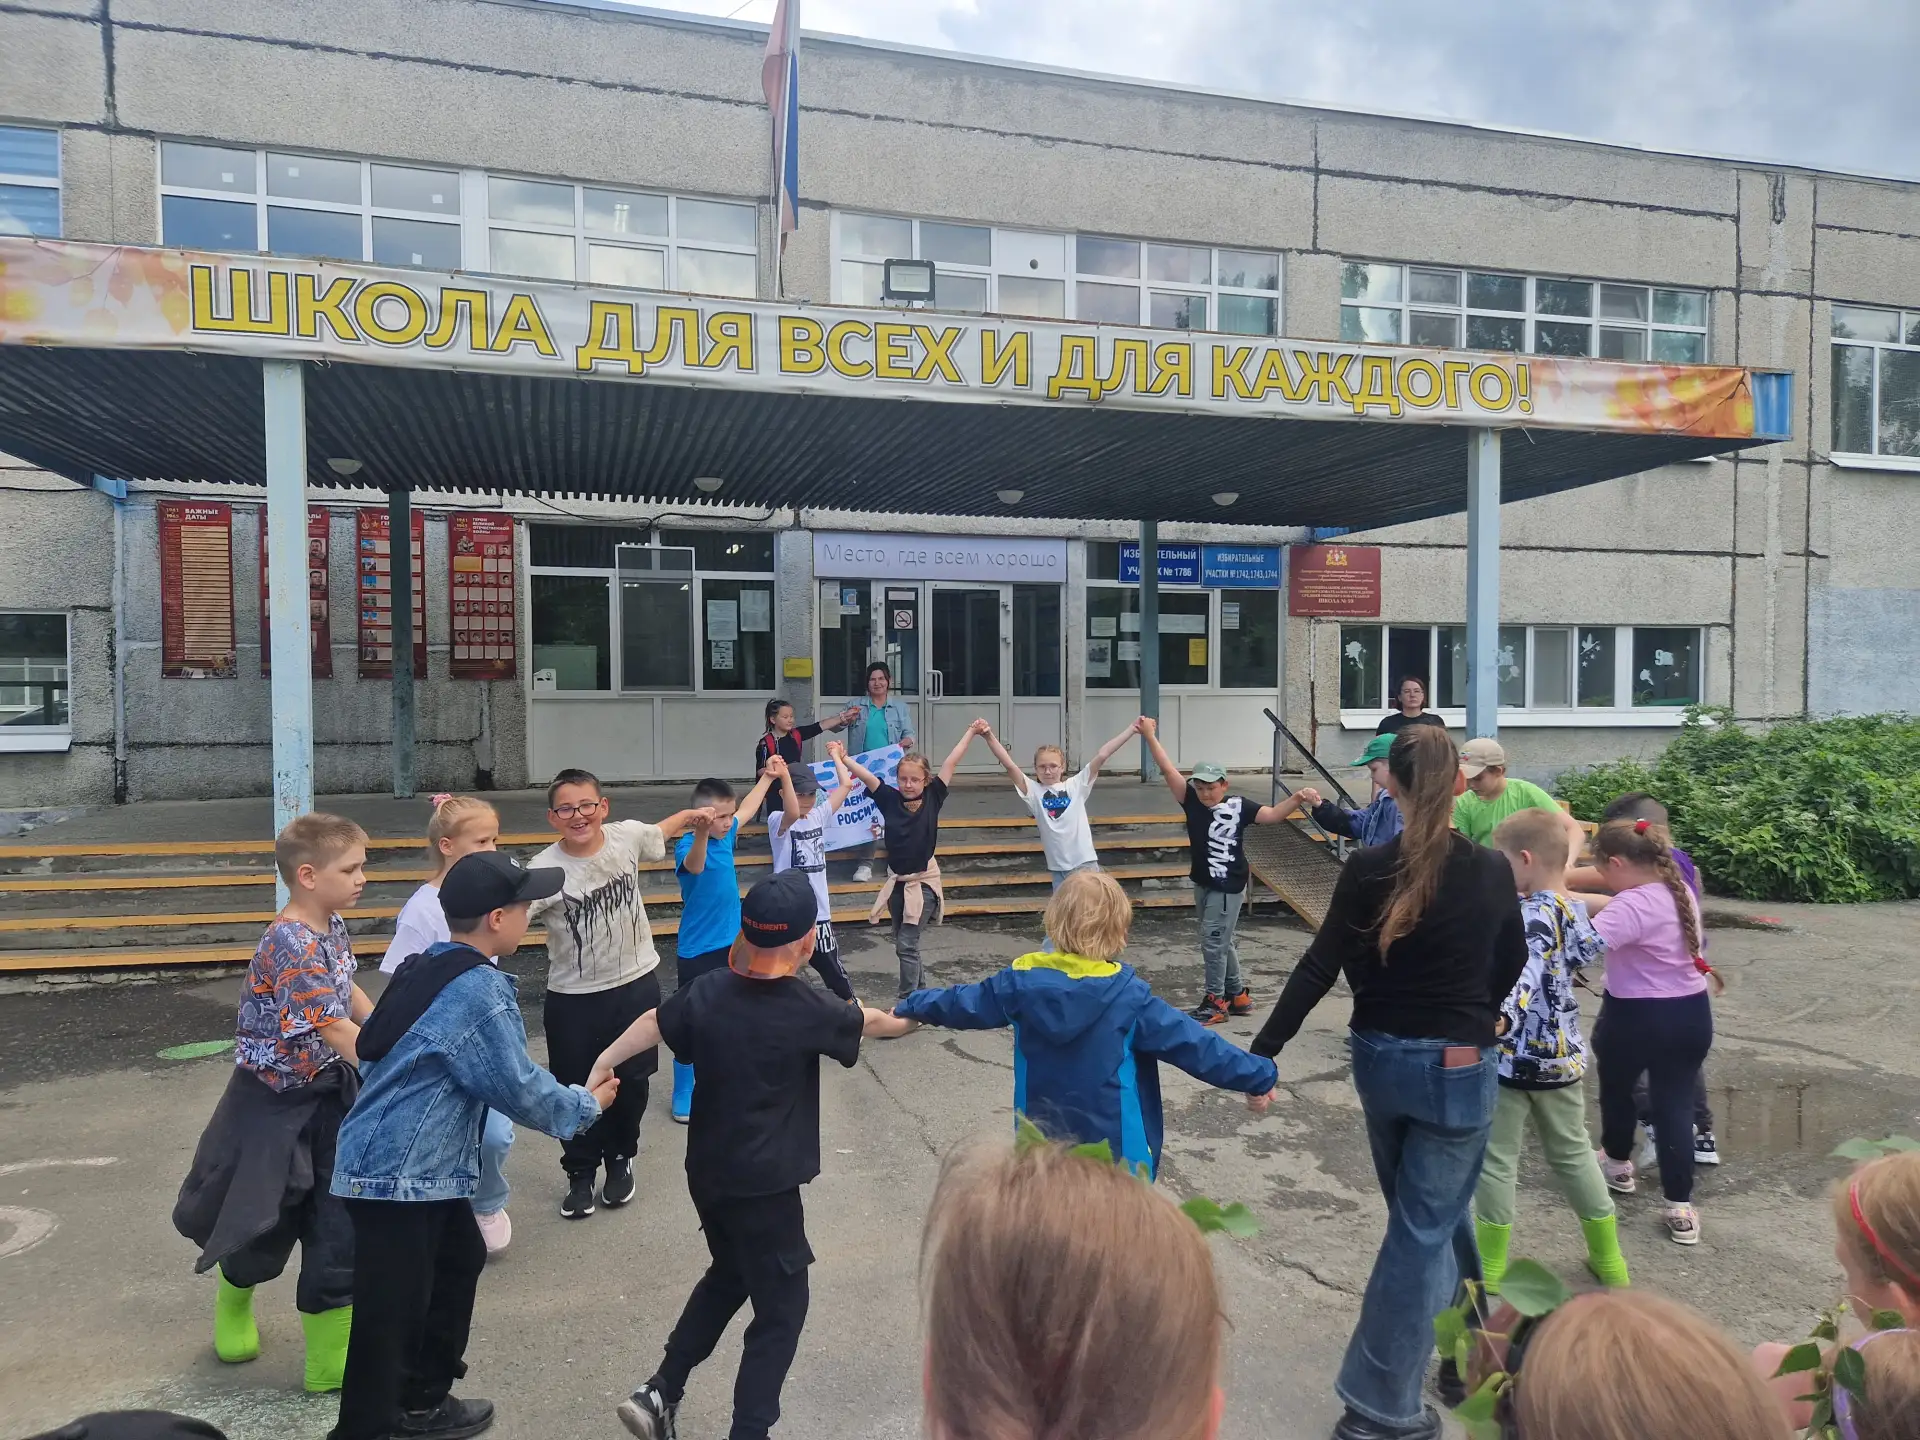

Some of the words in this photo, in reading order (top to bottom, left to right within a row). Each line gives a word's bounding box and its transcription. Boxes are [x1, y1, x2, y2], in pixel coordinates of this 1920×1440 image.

[190, 264, 559, 358] ШКОЛА
[575, 299, 755, 375] ДЛЯ
[777, 314, 963, 383] ВСЕХ
[979, 329, 1030, 387] И
[1046, 334, 1191, 402] ДЛЯ
[1211, 344, 1533, 416] КАЖДОГО!
[822, 543, 891, 567] Место,
[898, 549, 928, 566] где
[933, 550, 980, 565] всем
[986, 552, 1057, 568] хорошо
[1123, 548, 1197, 560] ИЗБТЕЛЬНЫЙ
[1217, 553, 1265, 563] ИЗБИРАТЕЛЬНЫЕ
[1174, 567, 1192, 577] 1786
[1204, 569, 1229, 578] УЧАСТКИ
[837, 801, 877, 826] РОССИИ
[753, 920, 788, 931] ELEMENTS
